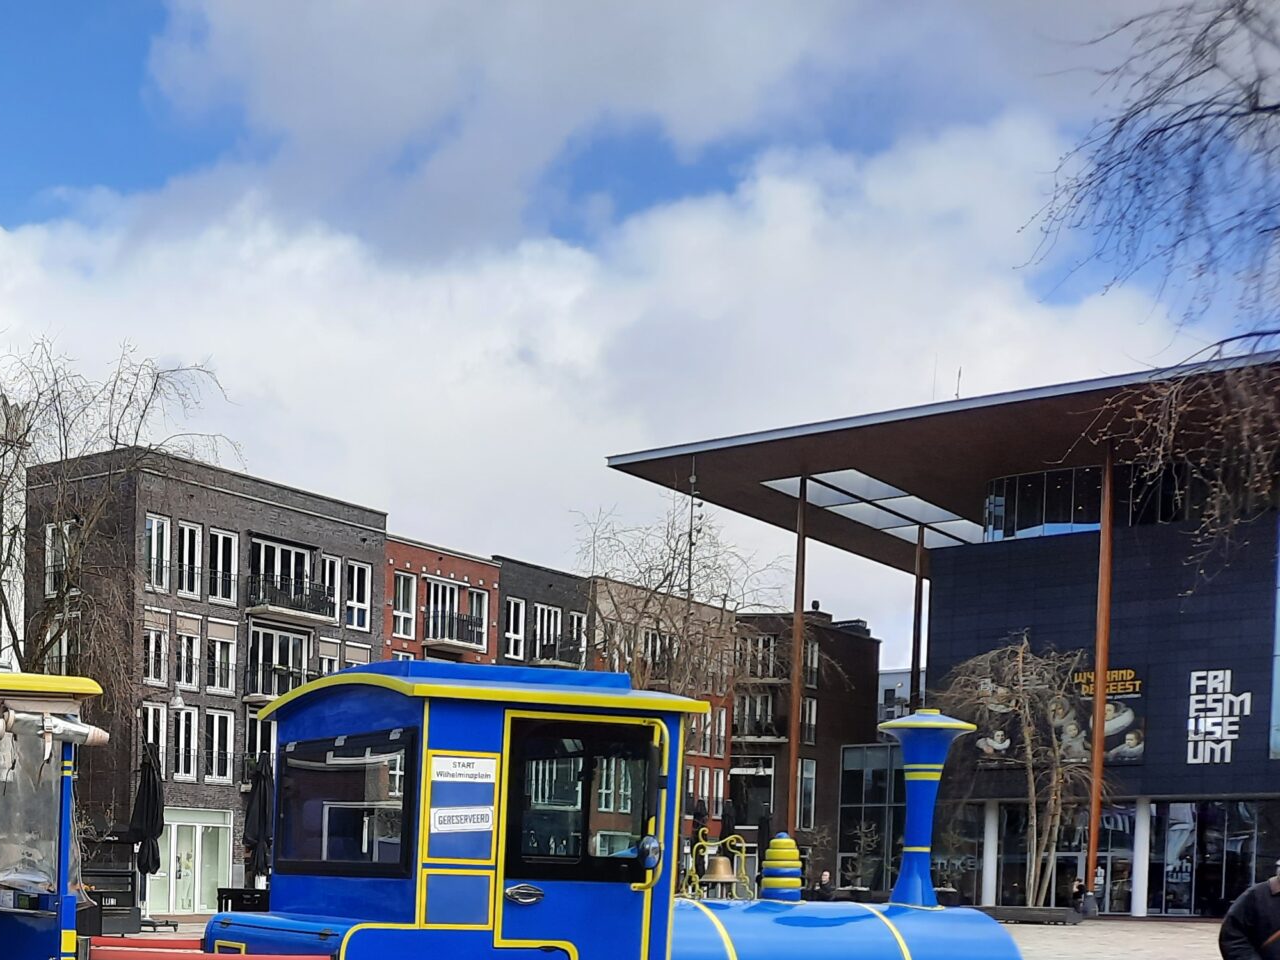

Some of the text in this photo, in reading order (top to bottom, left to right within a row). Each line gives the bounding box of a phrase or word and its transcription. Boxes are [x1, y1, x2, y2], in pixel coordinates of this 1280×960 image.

[1074, 669, 1135, 684] WYRAND
[1190, 669, 1231, 694] FRI
[1189, 692, 1251, 717] ESM
[1187, 716, 1240, 741] USE
[1187, 740, 1232, 764] UM
[452, 761, 475, 769] START
[436, 771, 491, 780] Wilhelminaplein
[438, 813, 490, 825] GERESERVEERD
